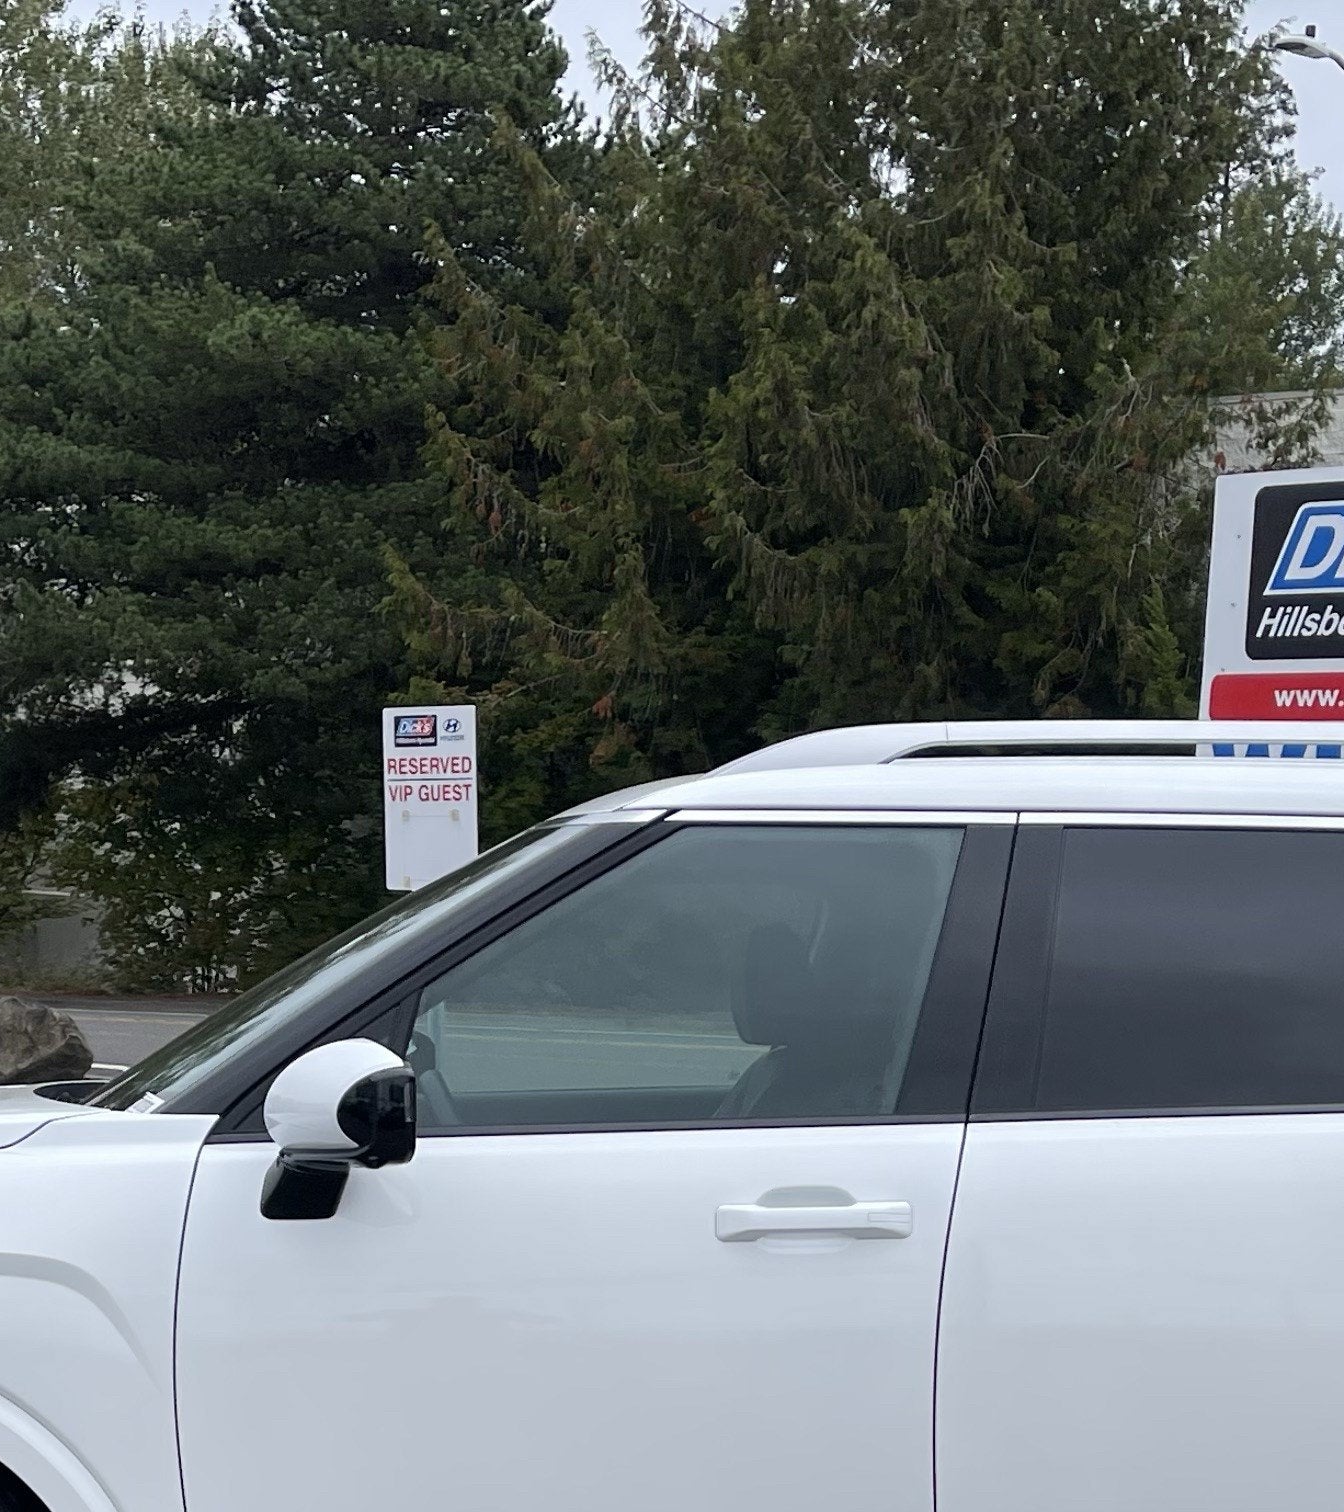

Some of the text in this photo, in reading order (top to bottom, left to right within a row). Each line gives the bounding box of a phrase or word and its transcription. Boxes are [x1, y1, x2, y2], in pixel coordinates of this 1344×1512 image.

[387, 756, 473, 775] RESERVED
[388, 784, 472, 802] VIP GUEST
